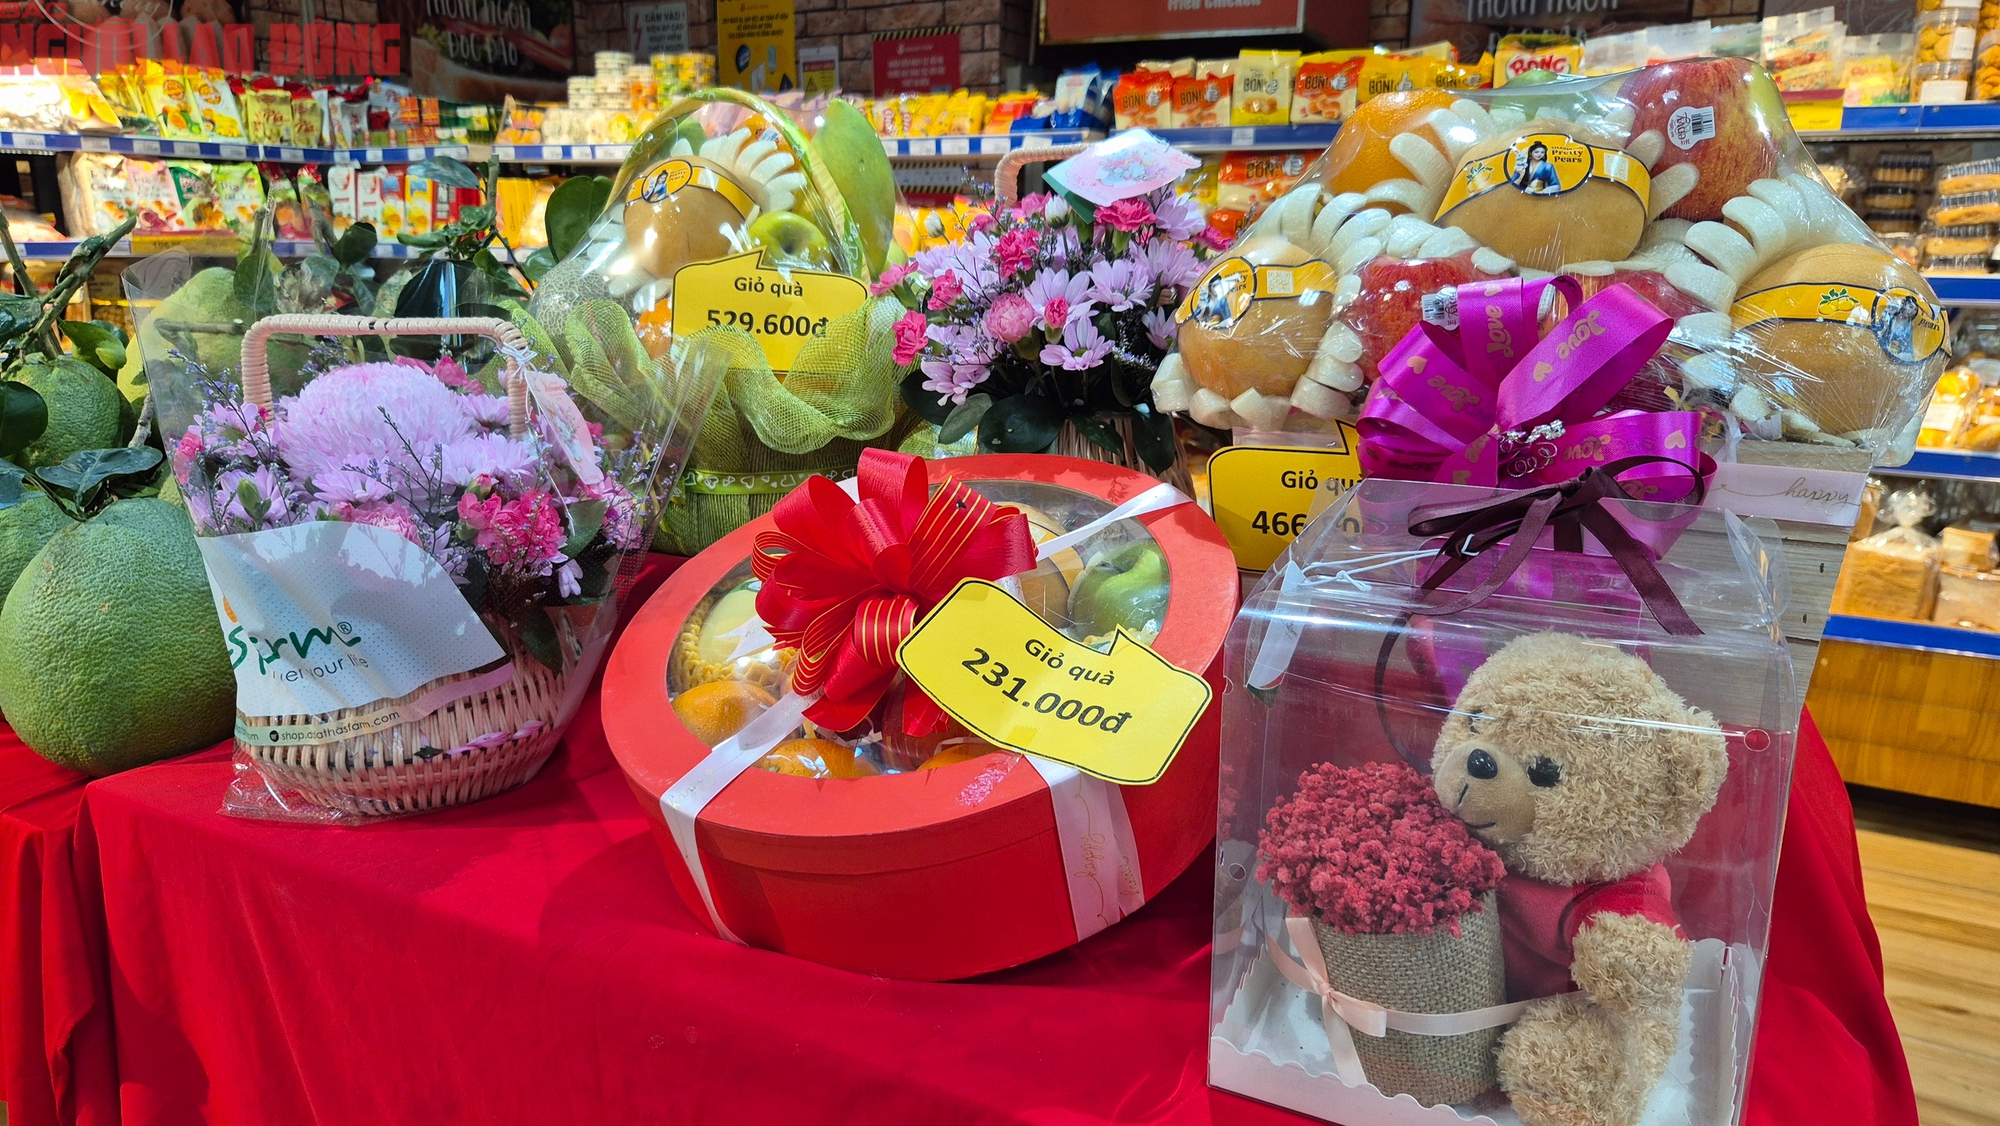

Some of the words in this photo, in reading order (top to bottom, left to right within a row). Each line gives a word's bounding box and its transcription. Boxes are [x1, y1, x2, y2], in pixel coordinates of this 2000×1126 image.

[1551, 149, 1584, 158] Pretty
[734, 277, 765, 293] Giỏ
[770, 281, 804, 297] quà
[1556, 309, 1606, 360] Love
[1280, 469, 1318, 490] Giỏ
[1025, 638, 1064, 670] Giỏ
[1068, 663, 1116, 687] quà
[961, 647, 1133, 734] 231.000đ
